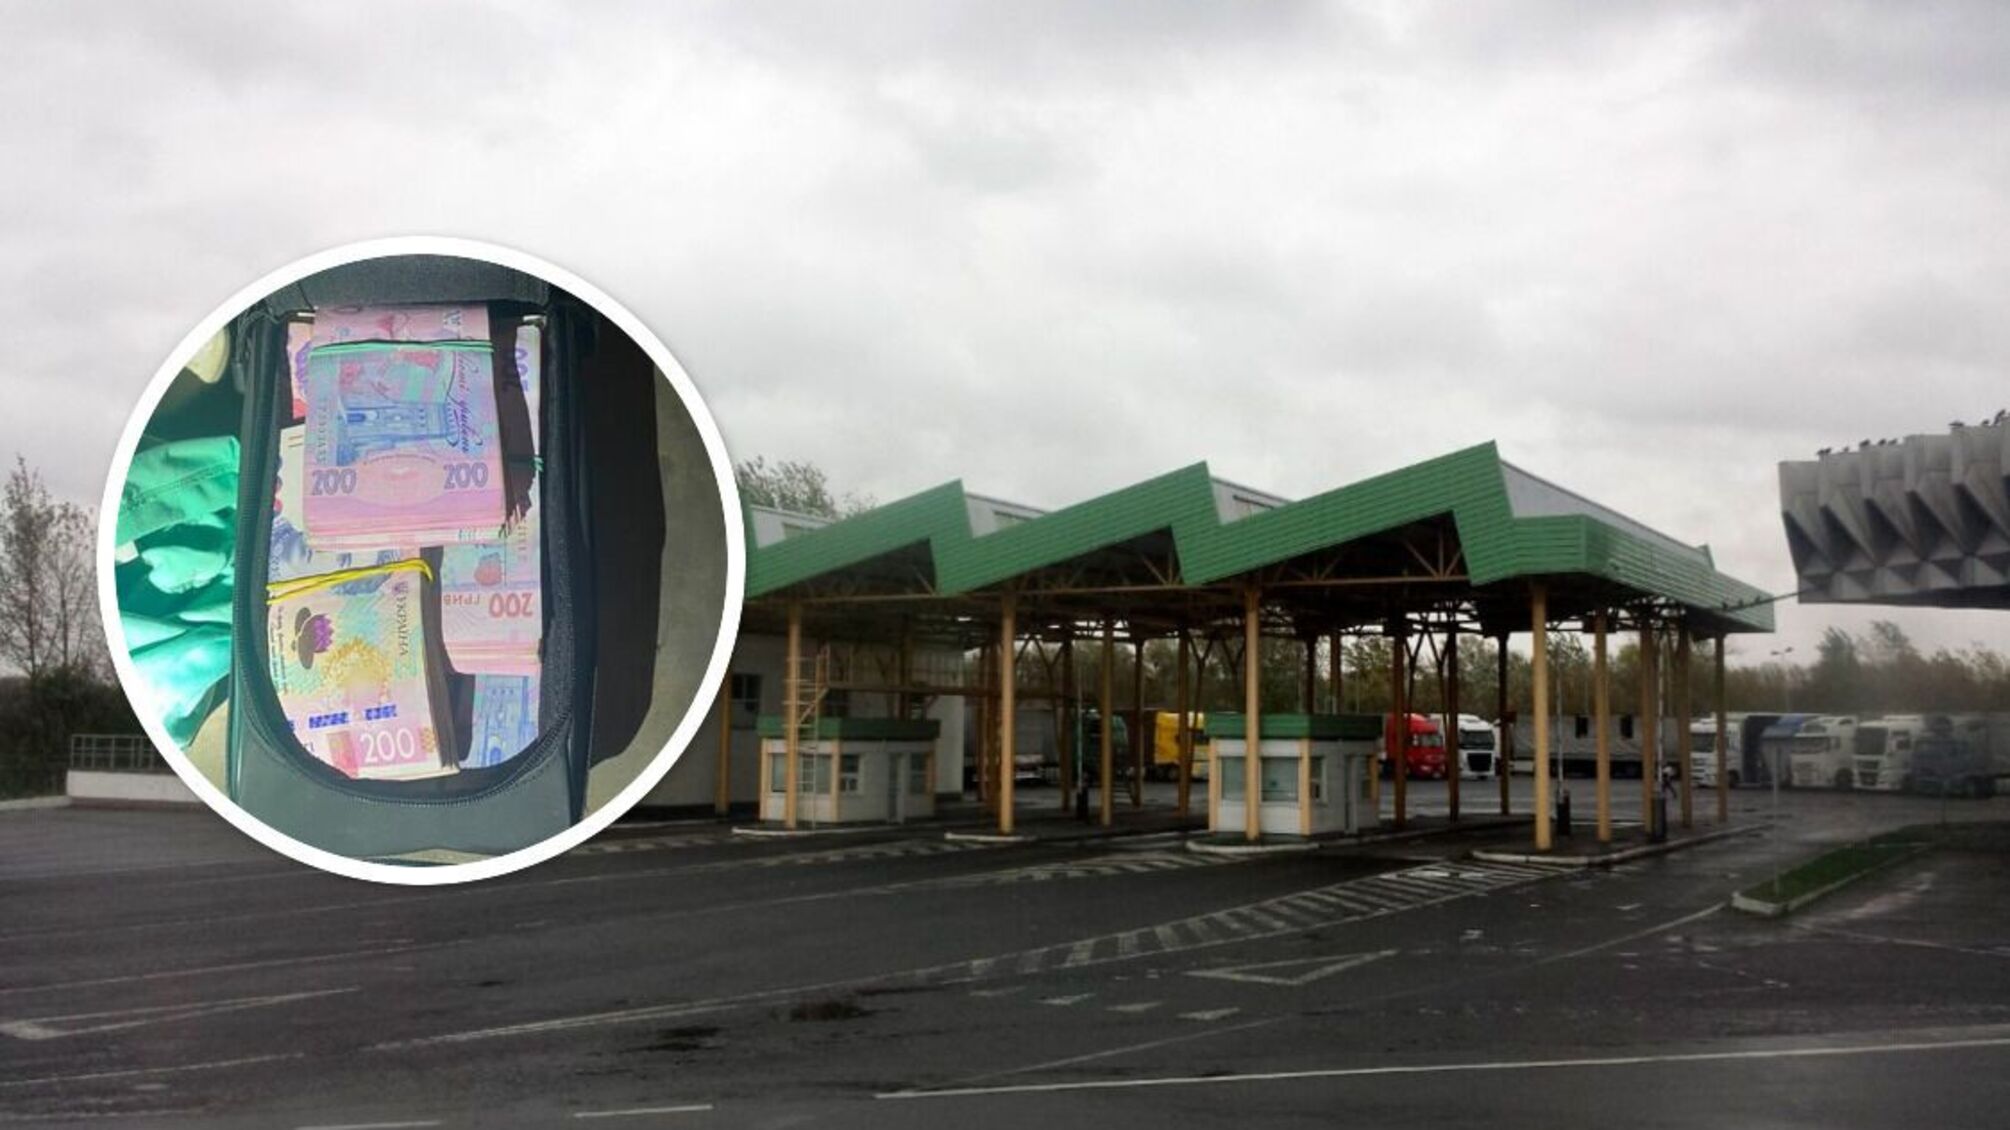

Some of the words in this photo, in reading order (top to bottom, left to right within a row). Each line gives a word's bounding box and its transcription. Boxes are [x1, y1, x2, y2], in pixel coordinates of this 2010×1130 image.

[310, 469, 357, 496] 200
[443, 462, 488, 490] 200
[488, 592, 534, 620] 200
[396, 596, 409, 656] УКРАЇНА
[360, 728, 416, 763] 200
